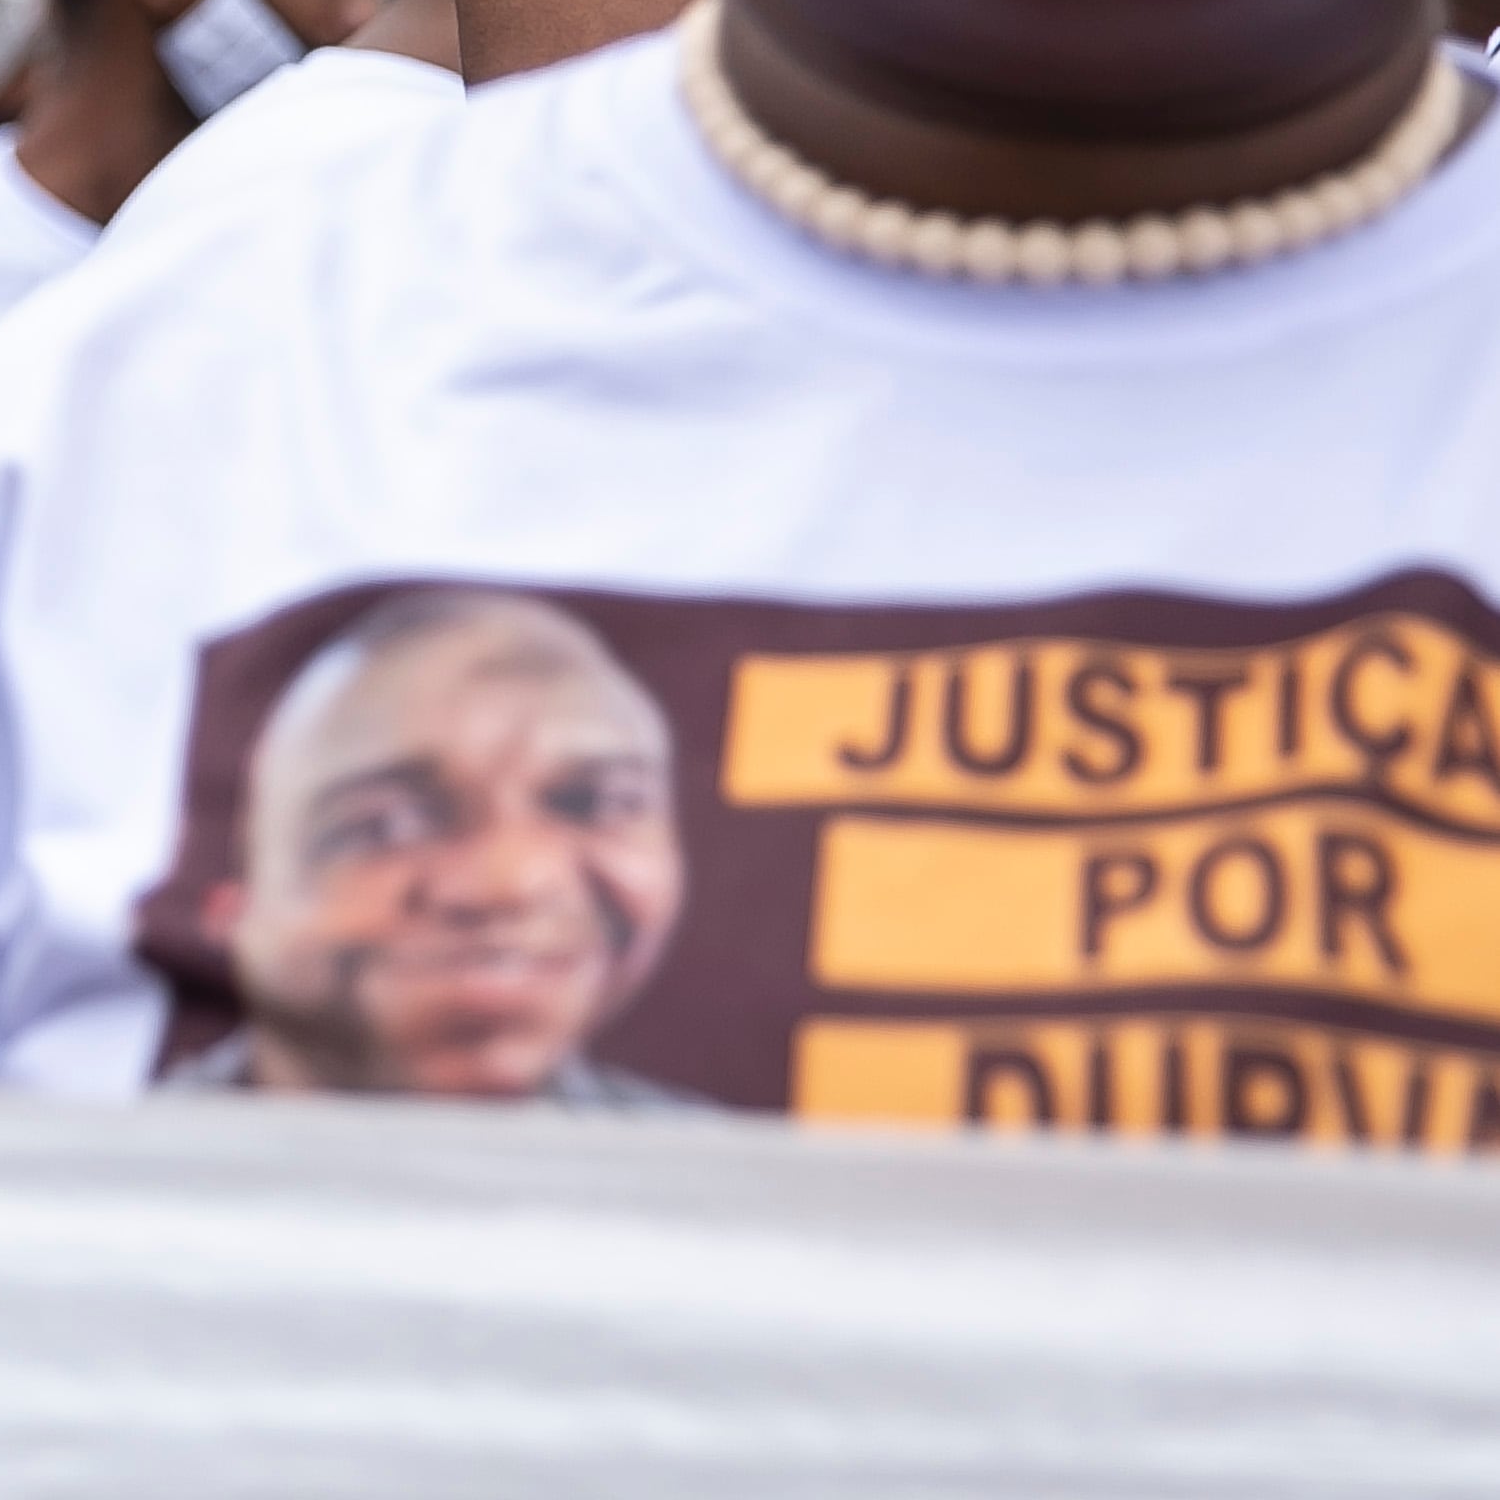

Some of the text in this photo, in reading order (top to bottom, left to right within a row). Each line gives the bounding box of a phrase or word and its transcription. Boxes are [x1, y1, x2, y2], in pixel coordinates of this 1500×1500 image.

[836, 630, 1500, 800] JUSTIÇA
[1078, 830, 1409, 976] POR
[965, 1040, 1500, 1156] DURV
